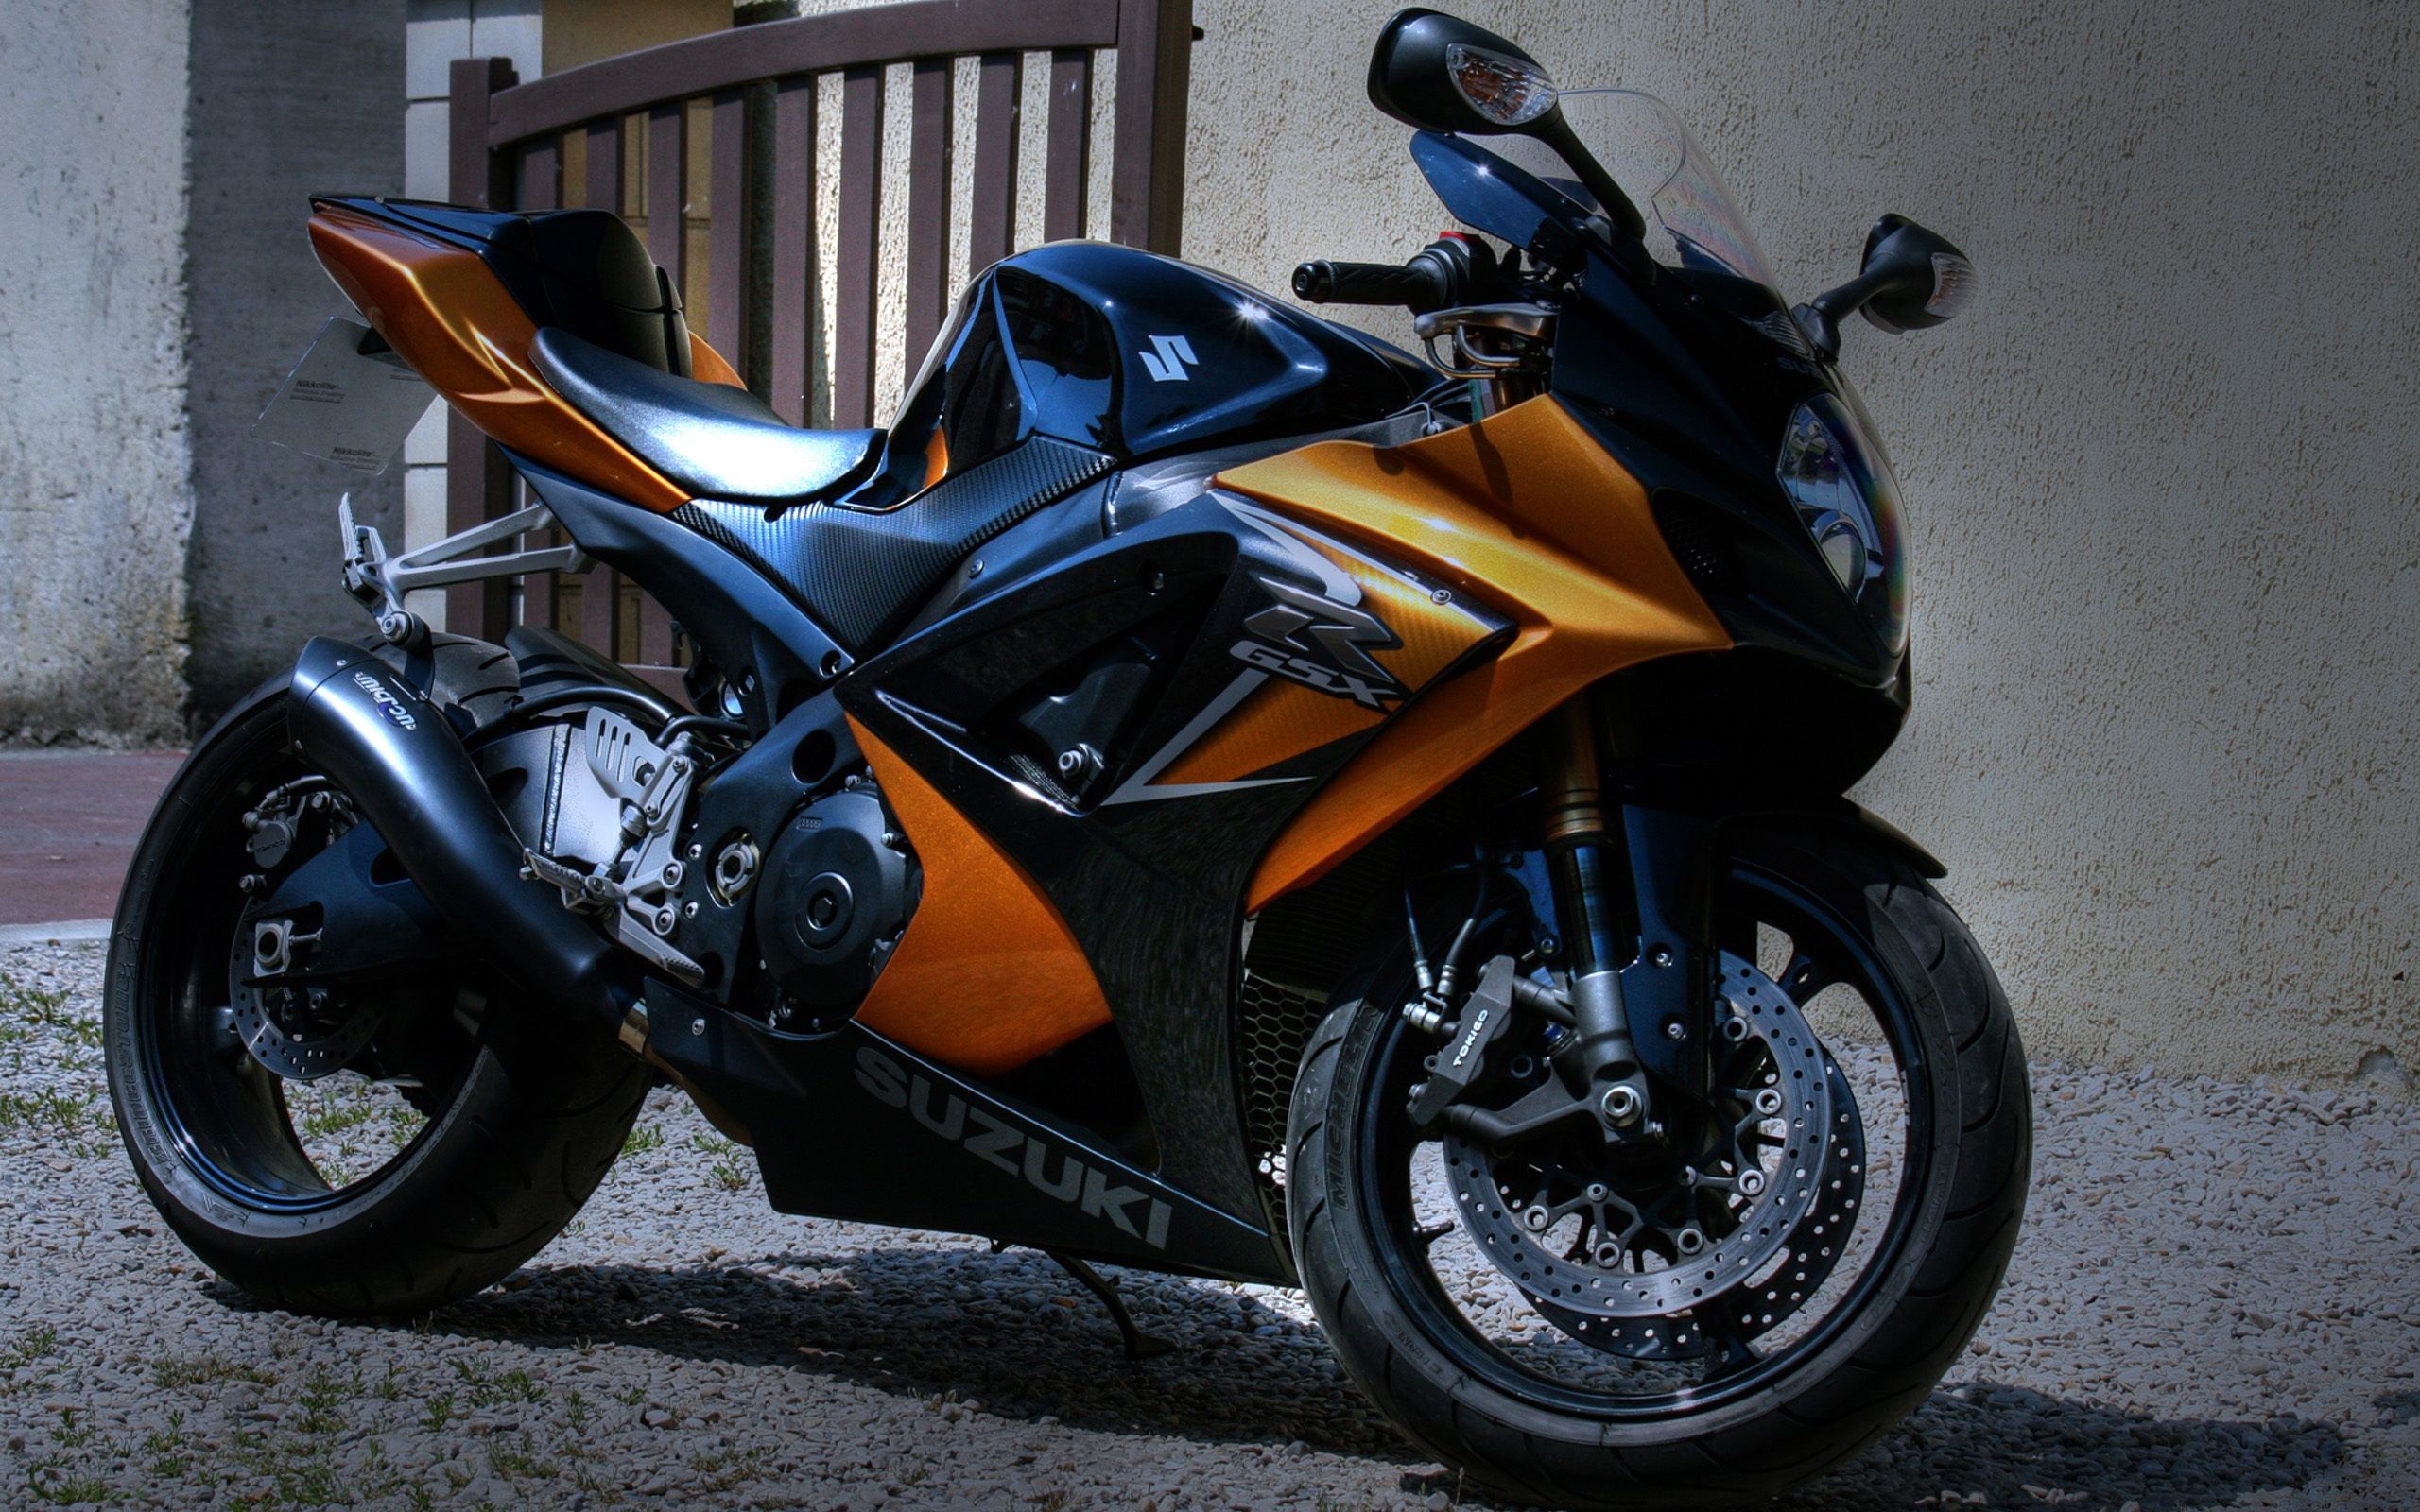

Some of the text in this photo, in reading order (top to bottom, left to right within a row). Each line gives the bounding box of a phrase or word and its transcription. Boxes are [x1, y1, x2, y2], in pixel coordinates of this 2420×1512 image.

[1325, 1004, 1378, 1210] MICHELIN
[1452, 1009, 1489, 1067] TOKICO
[854, 1045, 1173, 1251] SUZUKI
